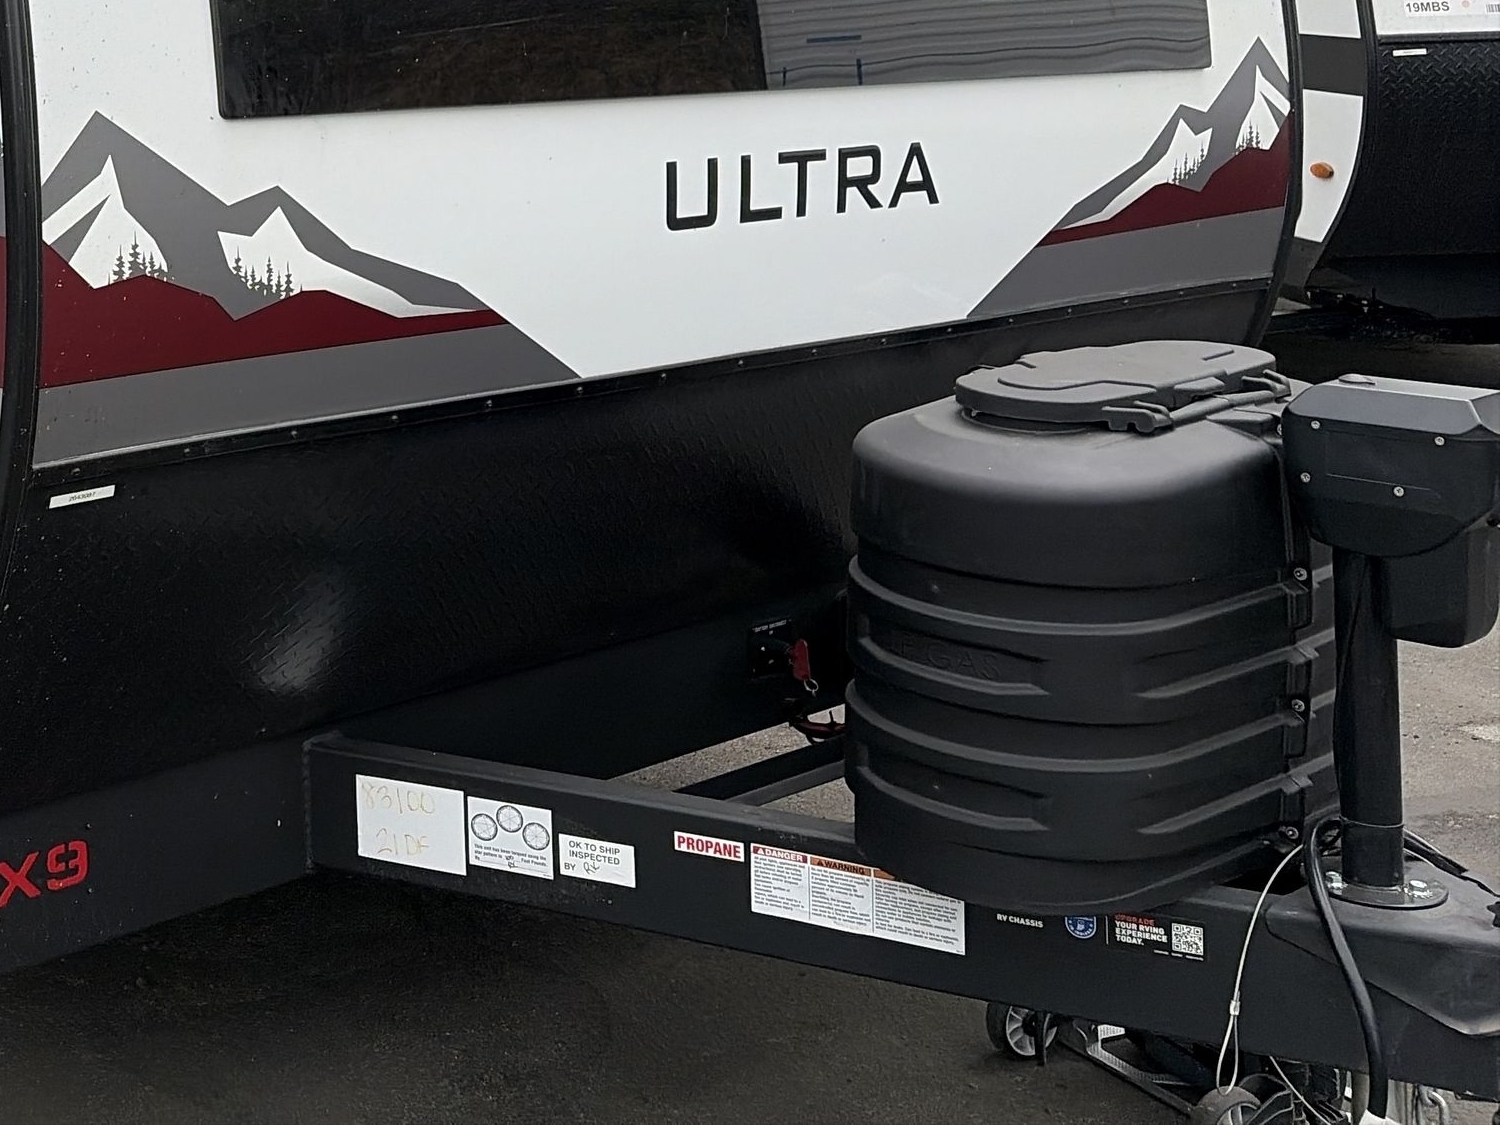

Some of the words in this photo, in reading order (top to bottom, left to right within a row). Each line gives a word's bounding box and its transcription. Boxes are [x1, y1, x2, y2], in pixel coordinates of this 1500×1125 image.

[1405, 1, 1450, 13] 19MBS
[666, 142, 940, 231] ULTRA
[569, 840, 583, 849] OK
[584, 842, 597, 852] TO
[599, 845, 620, 855] SHIP
[677, 835, 742, 859] PROPANE
[569, 850, 620, 865] INSPECTED
[765, 849, 804, 862] DANGER
[564, 862, 576, 871] BY
[824, 859, 865, 875] WARNING
[996, 913, 1008, 922] RV
[1008, 915, 1044, 928] CHASSIS
[1114, 920, 1138, 930] YOUR
[1138, 924, 1165, 935] RVING
[1115, 927, 1168, 943] EXPERIENCE
[1115, 934, 1145, 946] TODAY.
